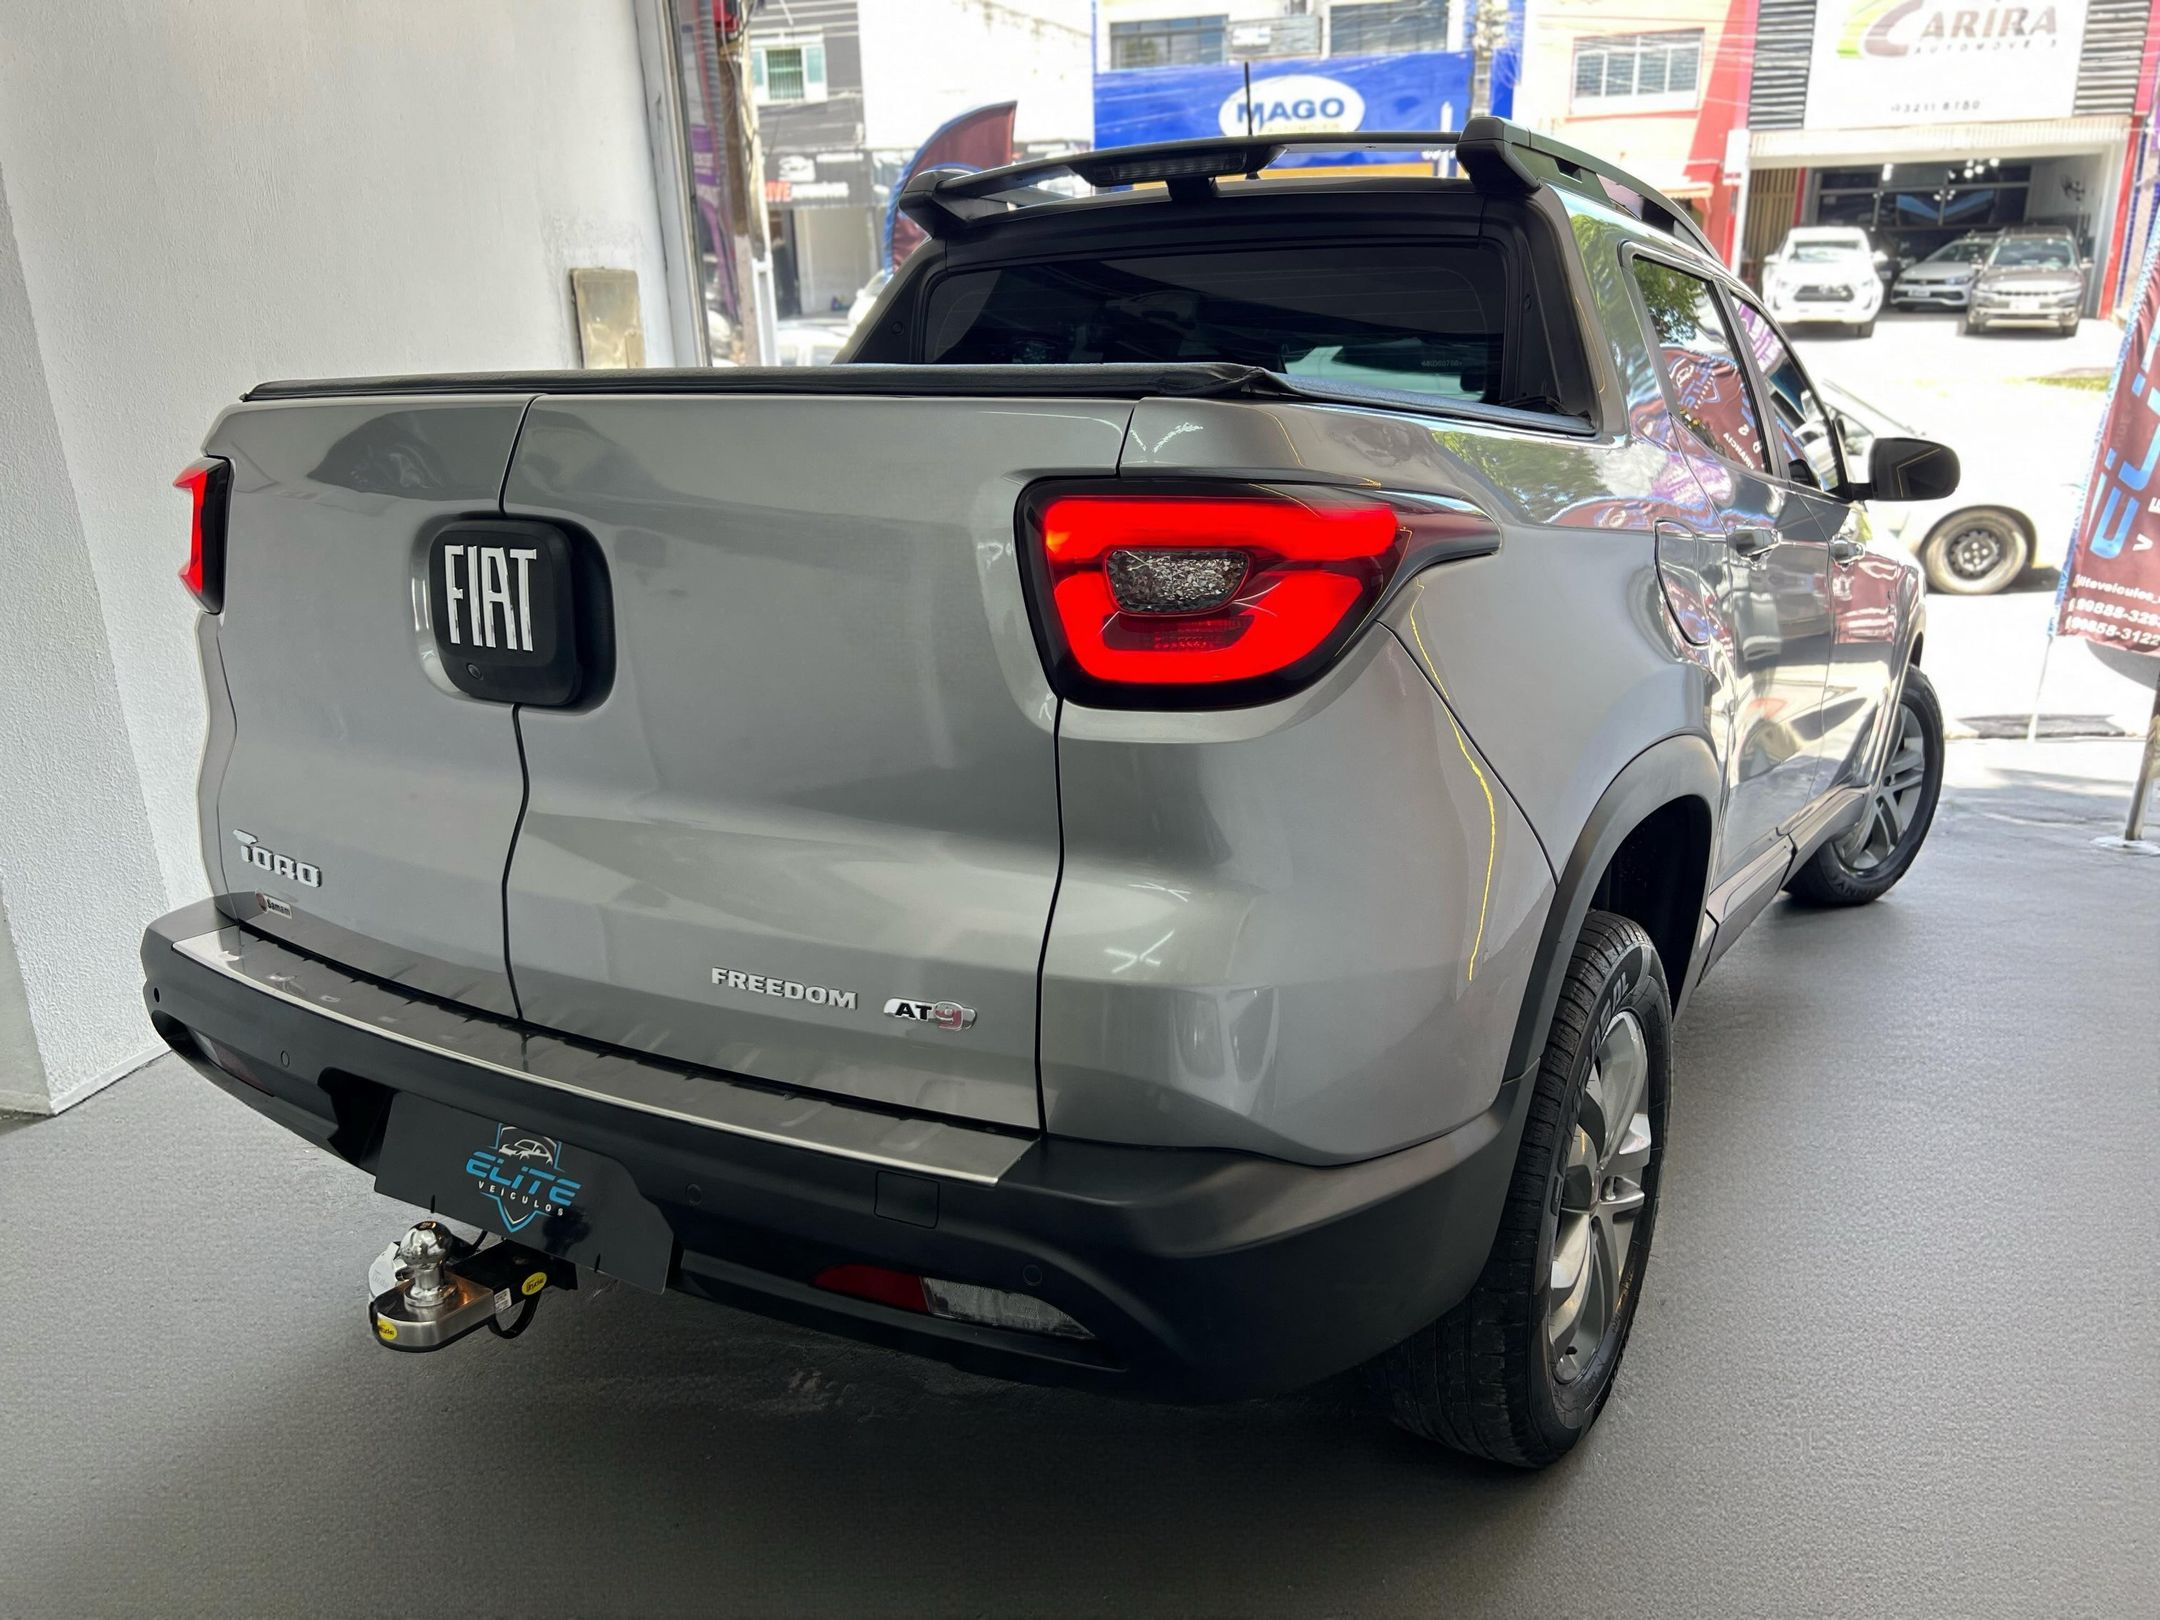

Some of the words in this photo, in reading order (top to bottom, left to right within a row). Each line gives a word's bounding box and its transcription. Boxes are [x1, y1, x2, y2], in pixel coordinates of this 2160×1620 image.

[1864, 0, 2058, 57] CARIRA
[1236, 98, 1346, 126] MAGO
[444, 545, 537, 651] FIAT
[233, 829, 322, 888] TORO
[711, 967, 858, 1010] FREEDOM
[895, 1001, 964, 1031] AT9
[465, 1151, 582, 1207] ELITE
